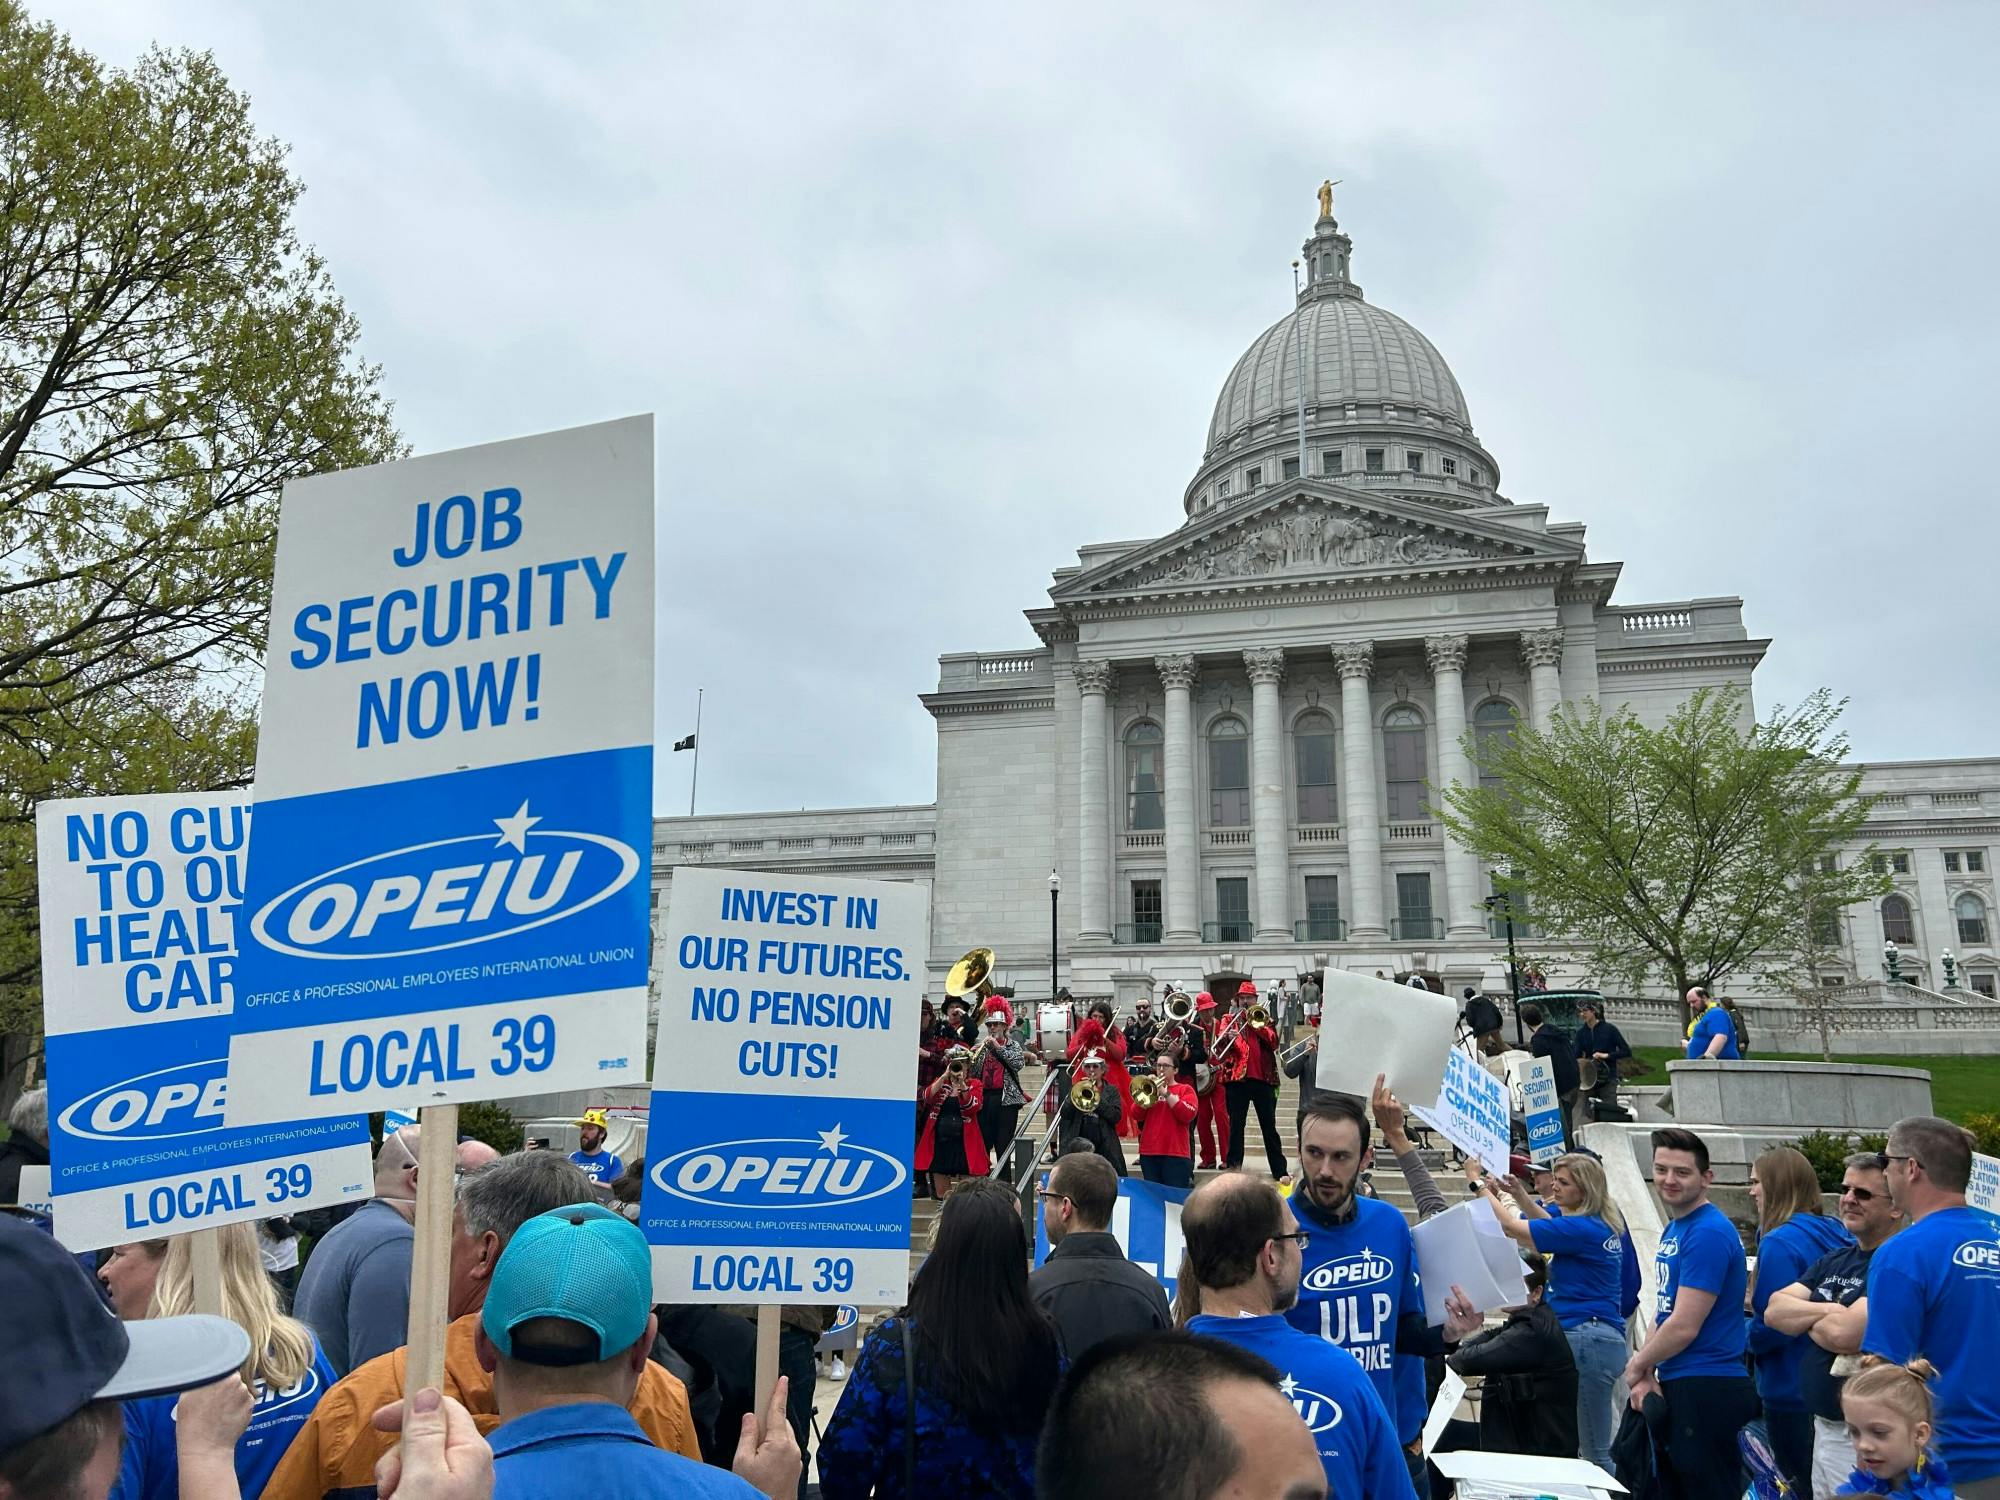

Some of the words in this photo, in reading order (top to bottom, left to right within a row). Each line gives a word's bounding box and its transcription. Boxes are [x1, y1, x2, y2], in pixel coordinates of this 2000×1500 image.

[393, 487, 523, 568] JOB
[290, 552, 628, 670] SECURITY
[356, 653, 541, 749] NOW!
[66, 811, 149, 862] NO
[86, 860, 164, 912] TO
[287, 850, 584, 946] OPEIU
[721, 888, 838, 927] INVEST
[846, 896, 878, 930] IN
[246, 991, 290, 1007] OFFICE
[292, 989, 301, 1001] &
[304, 975, 399, 1000] PROFESSIONAL
[402, 966, 479, 989] EMPLOYEES
[482, 953, 586, 977] INTERNATIONAL
[589, 947, 635, 964] UNION
[679, 935, 749, 972] OUR
[758, 940, 910, 982] FUTURES.
[691, 987, 740, 1022] NO
[749, 990, 892, 1030] PENSION
[309, 1024, 475, 1097] LOCAL
[490, 1014, 556, 1076] 39
[738, 1040, 838, 1079] CUTS!
[1531, 1066, 1543, 1079] JOB
[1524, 1079, 1553, 1095] SECURITY
[1533, 1095, 1550, 1108] NOW!
[1451, 1112, 1480, 1142] OPEIU
[1533, 1123, 1557, 1138] OPEIU
[62, 1163, 100, 1177] OFFICE
[102, 1161, 110, 1170] &
[112, 1149, 190, 1169] PROFESSIONAL
[192, 1138, 252, 1155] EMPLOYEES
[253, 1126, 328, 1146] INTERNATIONAL
[330, 1120, 360, 1134] UNION
[1979, 1160, 1999, 1174] THAN
[677, 1154, 874, 1196] OPEIU
[1975, 1183, 1980, 1192] A
[1982, 1184, 1995, 1197] PAY
[124, 1174, 256, 1230] LOCAL
[265, 1163, 313, 1203] 39
[647, 1219, 679, 1228] OFFICE
[681, 1219, 687, 1228] &
[688, 1220, 753, 1230] PROFESSIONAL
[756, 1220, 807, 1230] EMPLOYEES
[808, 1221, 874, 1232] INTERNATIONAL
[875, 1222, 902, 1233] UNION
[692, 1255, 803, 1292] LOCAL
[812, 1257, 854, 1293] 39
[1313, 1261, 1384, 1288] OPEIU
[1320, 1293, 1392, 1345] ULP
[1344, 1344, 1392, 1371] RIKE
